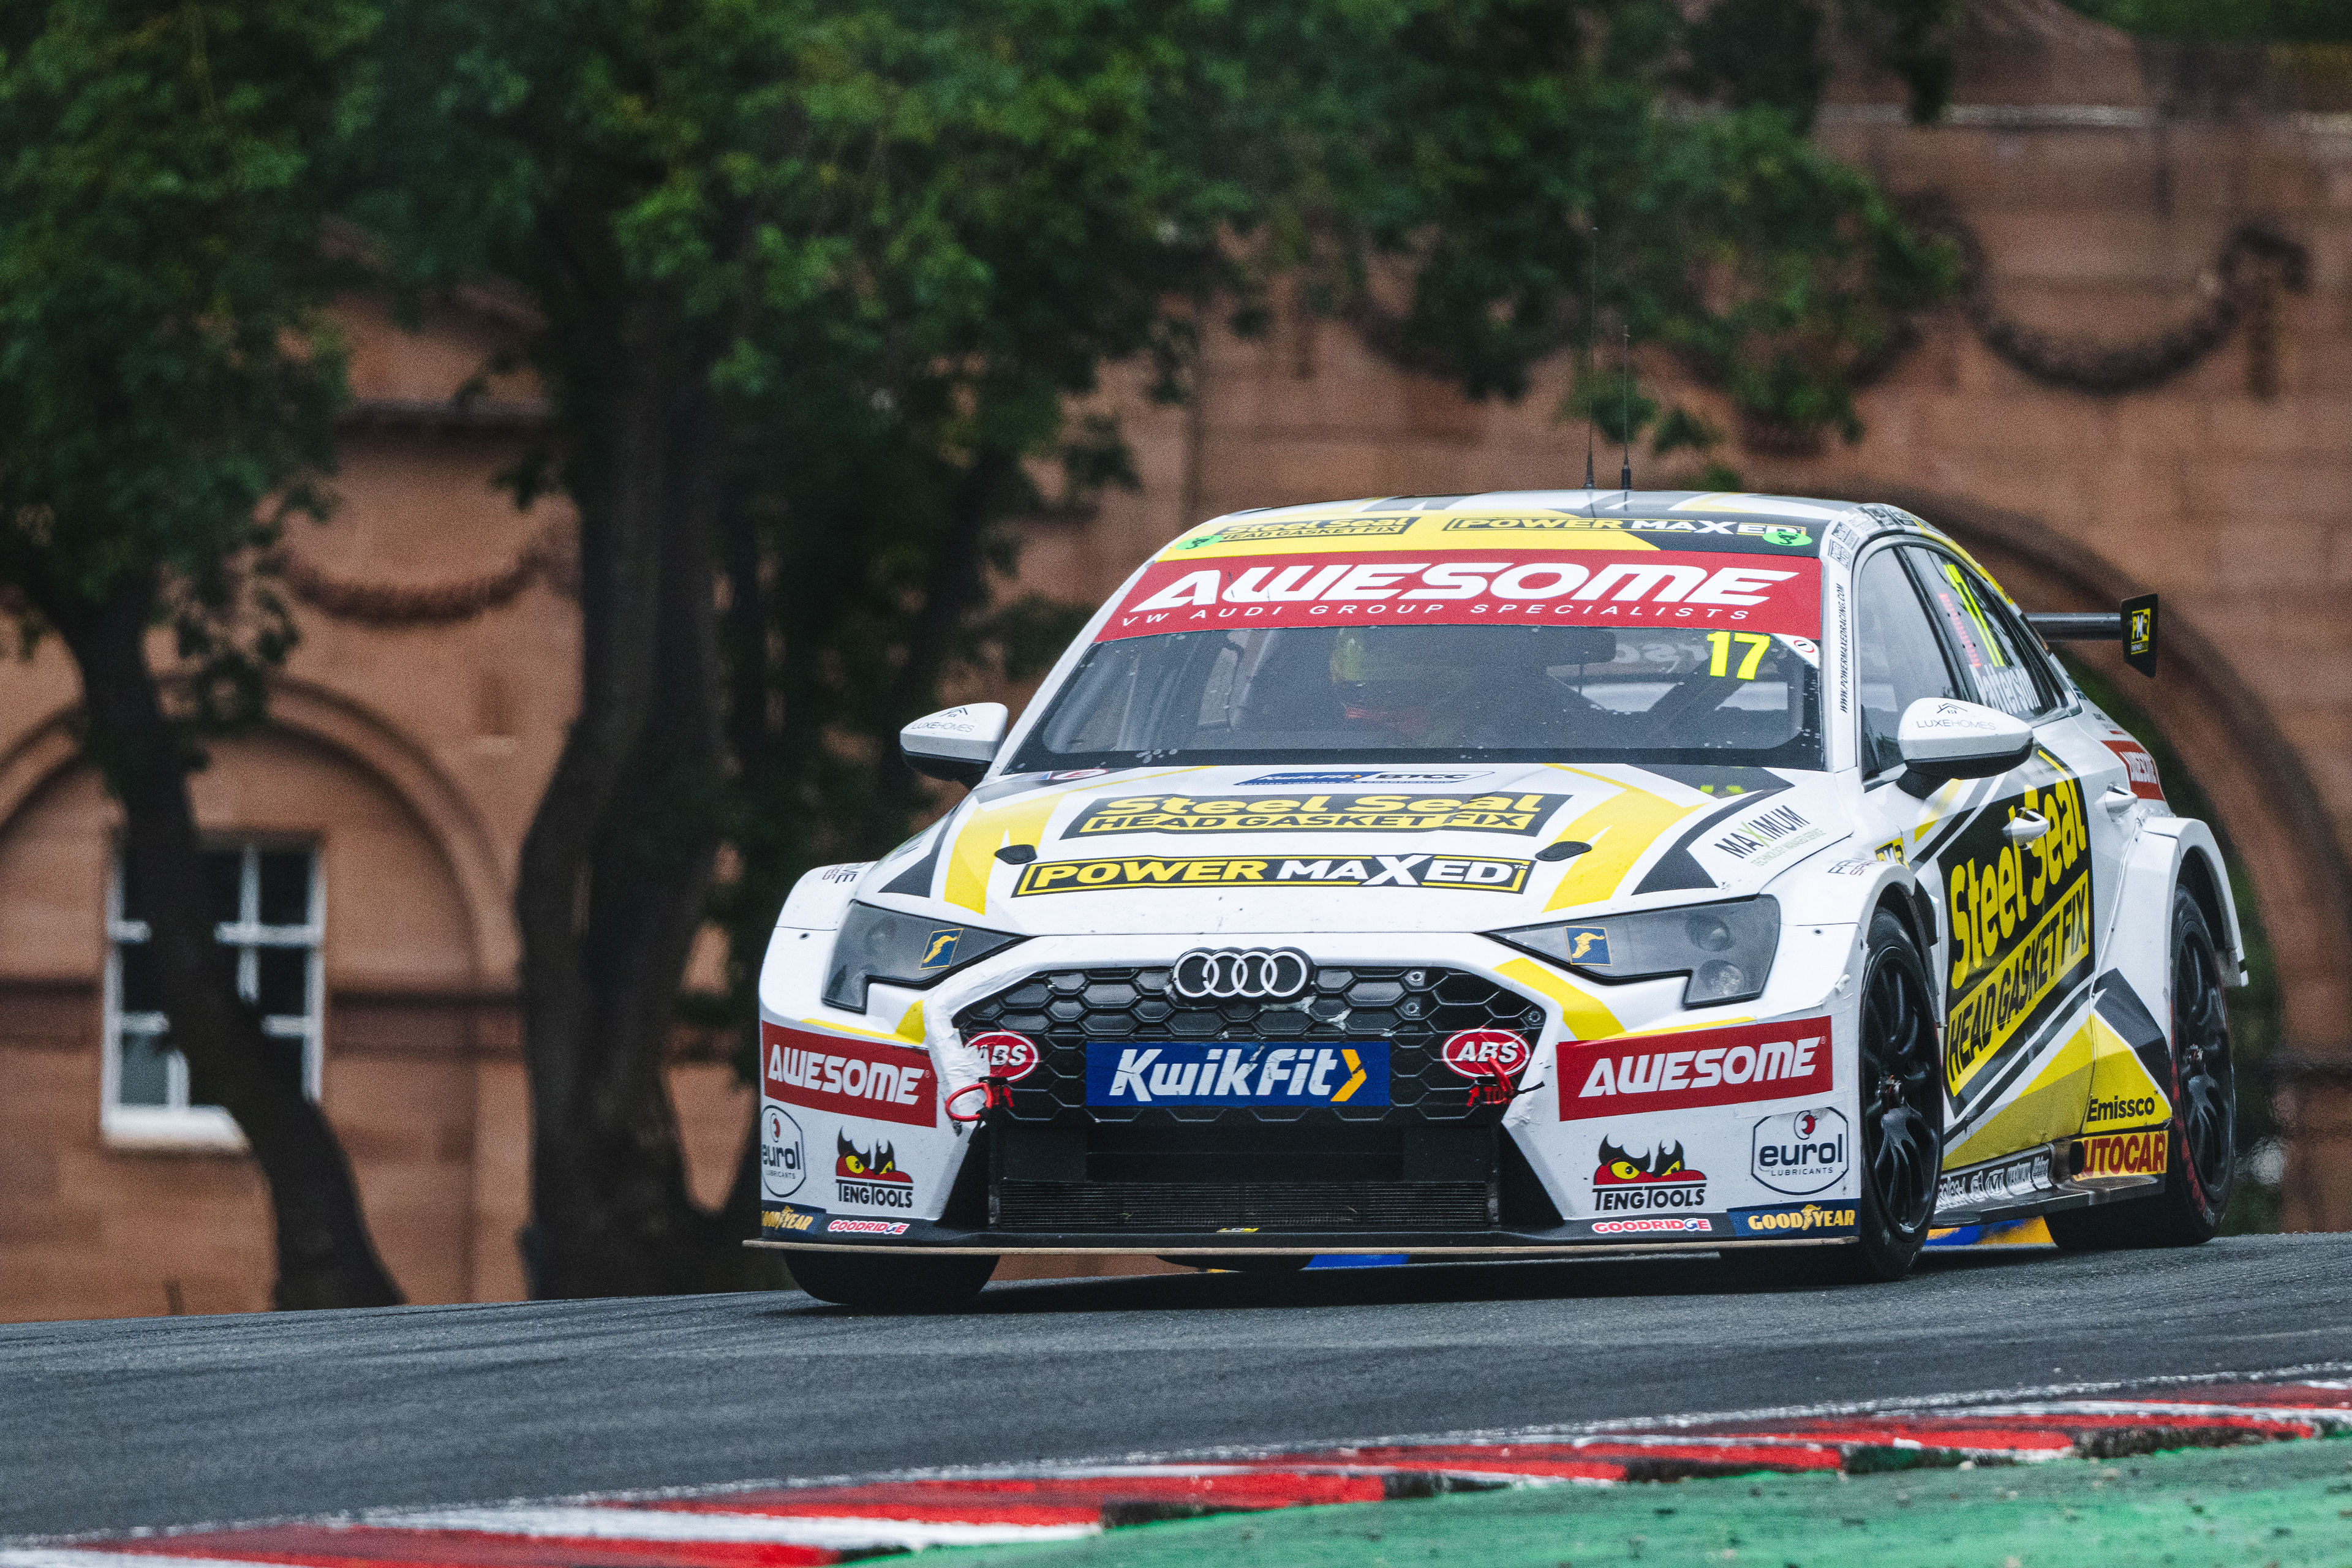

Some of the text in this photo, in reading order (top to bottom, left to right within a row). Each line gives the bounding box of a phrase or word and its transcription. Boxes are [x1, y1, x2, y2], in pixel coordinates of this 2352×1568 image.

[1224, 518, 1410, 534] Steel Seal
[1276, 528, 1355, 537] GASKET
[1457, 519, 1623, 529] POWER
[1130, 562, 1799, 612] AWESOME
[1122, 603, 1749, 627] VW AUDI GROUP SPECIALISTS
[1707, 631, 1770, 680] 17
[1836, 582, 1848, 714] WWW.POWERMAXEDRACING.COM
[1916, 719, 1997, 731] LUXEHOMES
[1096, 794, 1544, 815] Steel Seal
[1090, 813, 1526, 831] HEAD GASKET FIX
[1714, 805, 1811, 859] MAXIMUM
[1033, 861, 1268, 888] POWER
[1275, 855, 1513, 886] MAXED
[1950, 777, 2086, 990] Steel Seal
[1948, 882, 2087, 1082] HEAD GASKET FIX
[1455, 1041, 1519, 1063] ABS
[767, 1044, 925, 1106] AWESOME
[1578, 1037, 1821, 1098] AWESOME
[2086, 1095, 2155, 1122] Emissco
[762, 1141, 801, 1170] eurol
[1759, 1134, 1843, 1166] eurol
[2082, 1134, 2166, 1177] UTOCAR
[1771, 1167, 1834, 1177] LUBRICANTS
[827, 1219, 910, 1234] GOODRIDGE
[1593, 1218, 1713, 1234] GOODRIDGE
[1748, 1209, 1855, 1231] GOODYEAR
